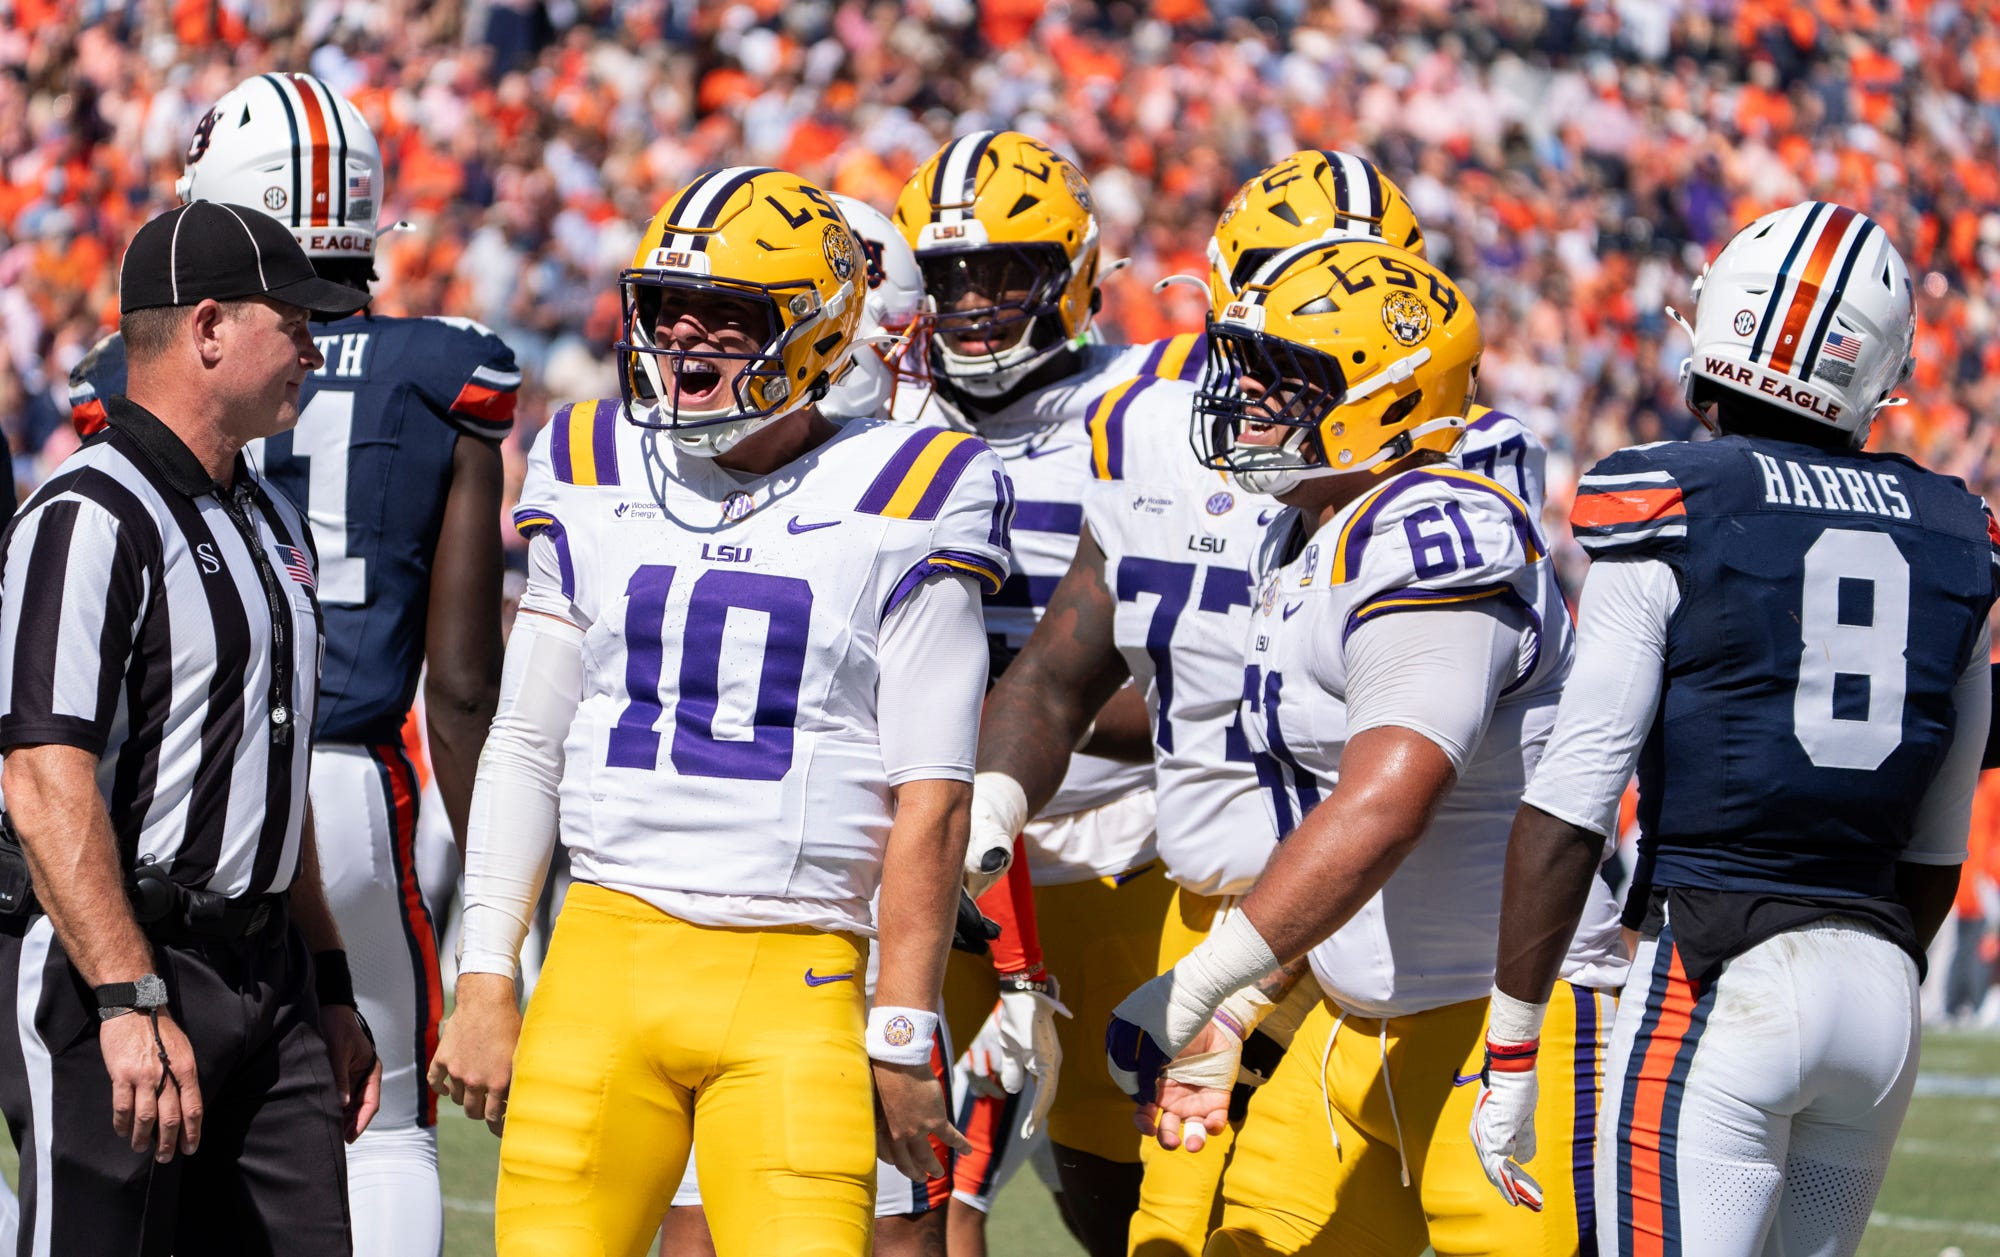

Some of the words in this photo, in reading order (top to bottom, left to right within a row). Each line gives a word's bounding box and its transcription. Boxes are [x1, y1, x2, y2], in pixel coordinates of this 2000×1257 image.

[933, 226, 965, 240] LSU
[310, 235, 372, 252] EAGLE
[656, 251, 692, 268] LSU
[1327, 255, 1458, 326] LSU
[1226, 304, 1248, 319] LSU
[1784, 334, 1793, 345] 8
[1705, 357, 1753, 386] WAR
[1758, 375, 1841, 422] EAGLE
[1753, 452, 1911, 519] HARRIS
[630, 510, 657, 519] Energy
[1188, 535, 1226, 553] LSU
[1403, 501, 1484, 580] 61
[701, 543, 752, 563] LSU
[1255, 634, 1270, 652] LSU
[1794, 528, 1910, 770] 8
[605, 564, 814, 782] 10
